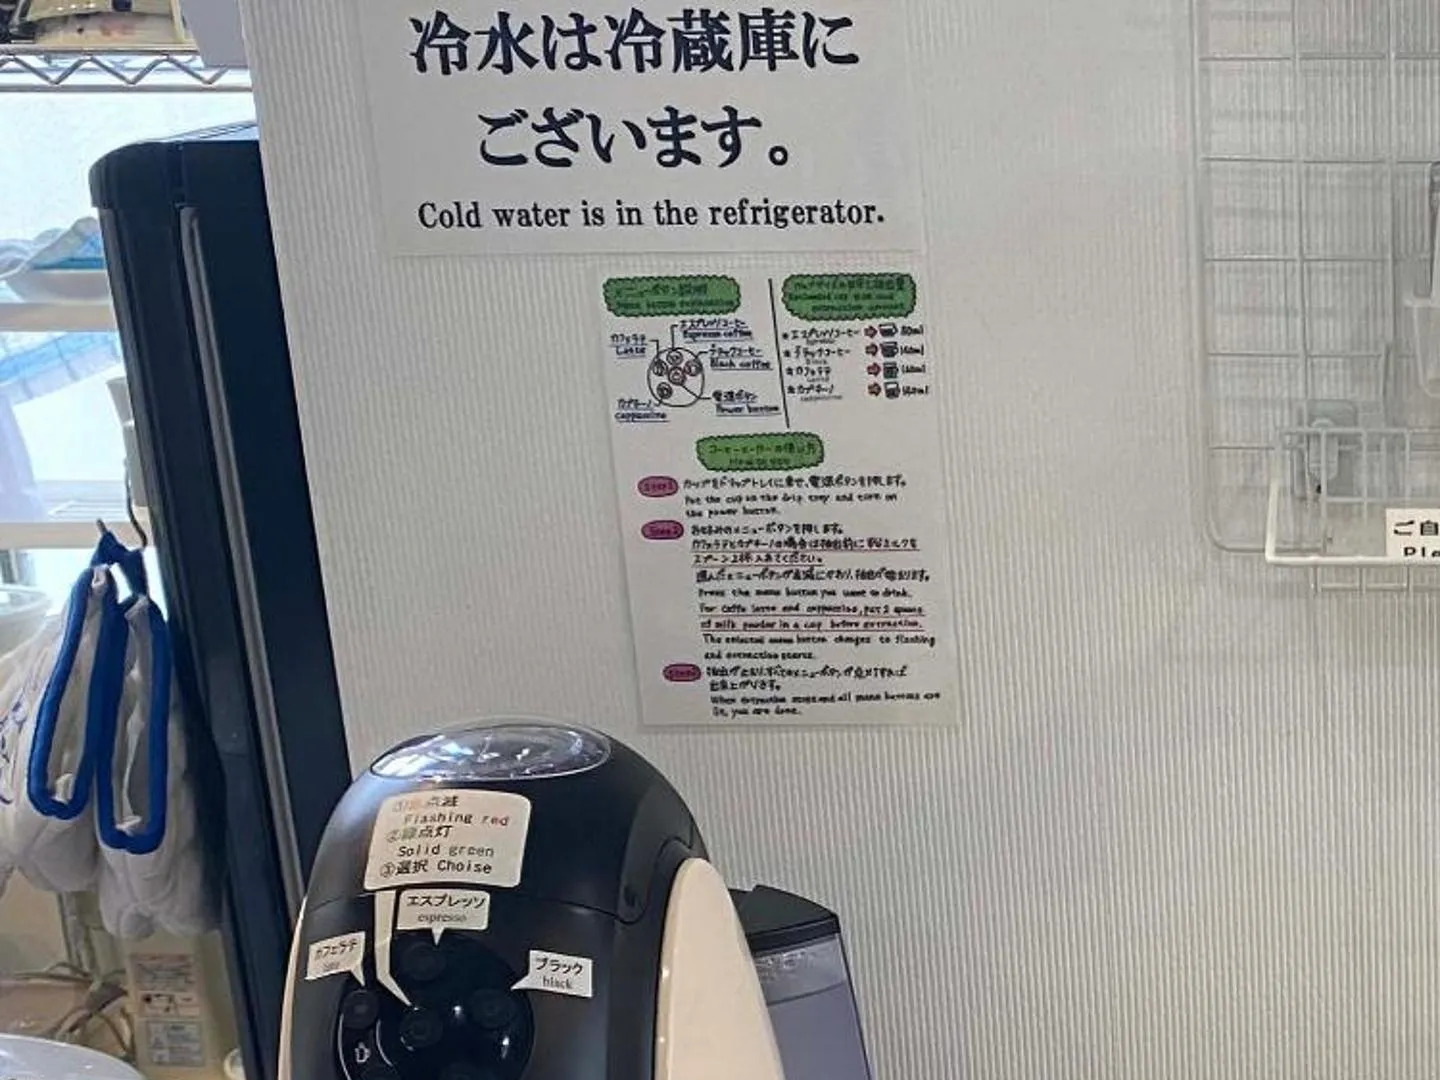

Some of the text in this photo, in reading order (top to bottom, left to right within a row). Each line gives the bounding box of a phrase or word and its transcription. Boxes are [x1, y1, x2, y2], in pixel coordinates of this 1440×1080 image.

[410, 7, 859, 75] 冷水は冷蔵庫に
[478, 105, 789, 168] ございます。
[419, 199, 884, 230] Cold water is in the refrigerator.
[482, 815, 509, 826] red
[398, 844, 494, 857] Solid green
[437, 860, 492, 874] Choise
[407, 895, 486, 908] エスプレッソ
[535, 957, 584, 976] ブラック
[541, 976, 573, 990] black
